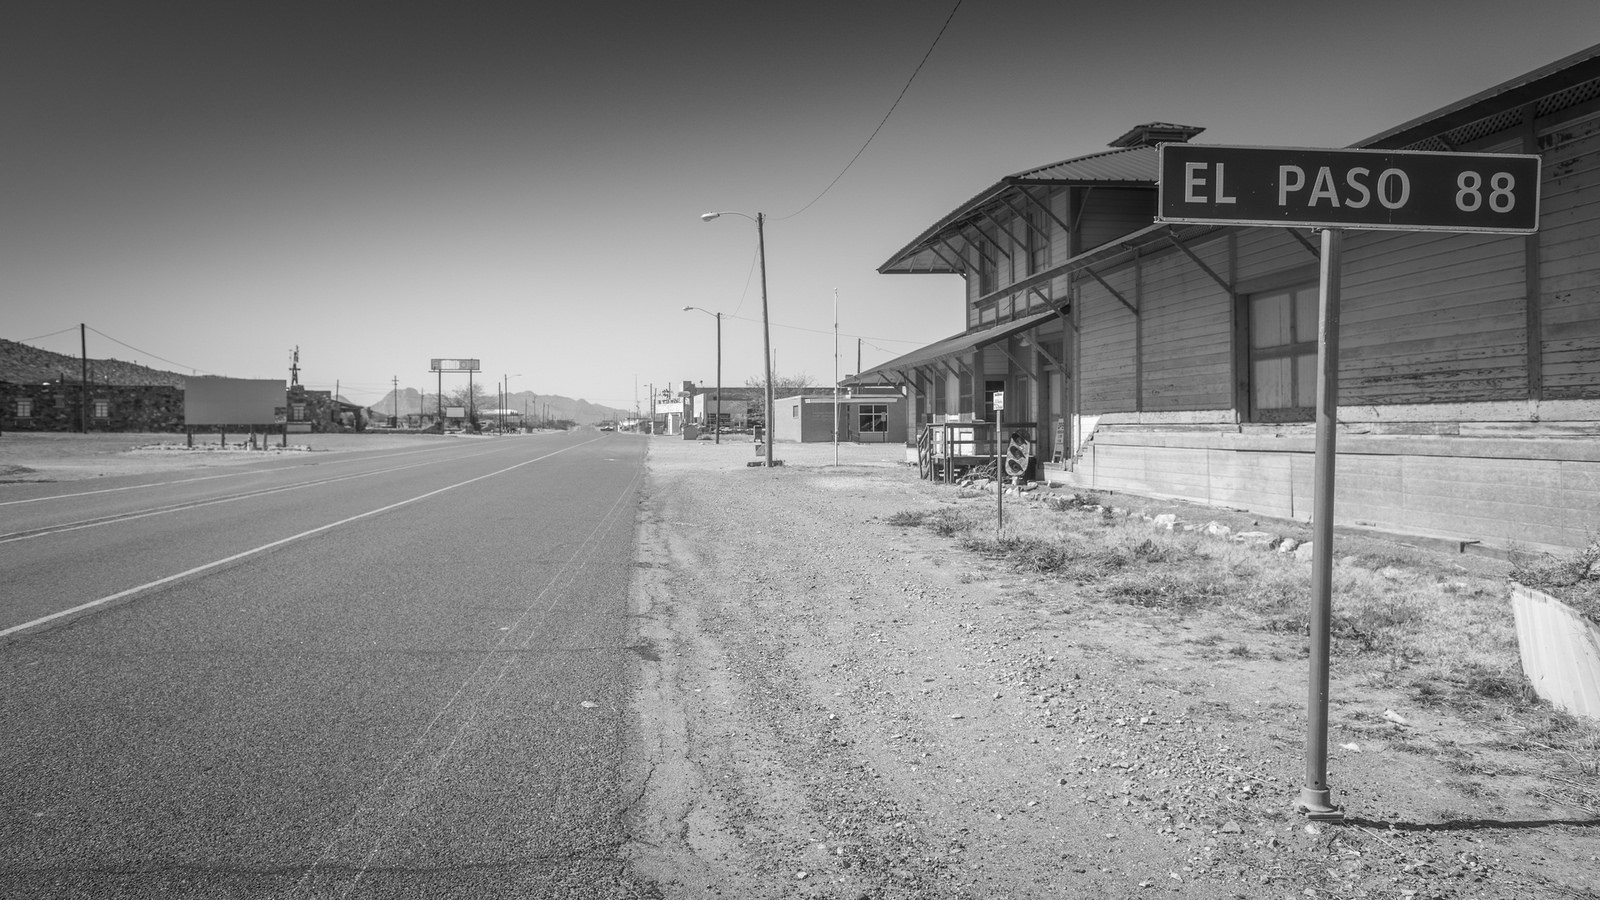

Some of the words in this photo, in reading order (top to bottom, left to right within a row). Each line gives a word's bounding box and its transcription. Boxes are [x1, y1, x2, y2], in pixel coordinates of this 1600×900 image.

[1184, 161, 1237, 204] EL
[1278, 165, 1411, 210] PASO
[1455, 170, 1516, 213] 88
